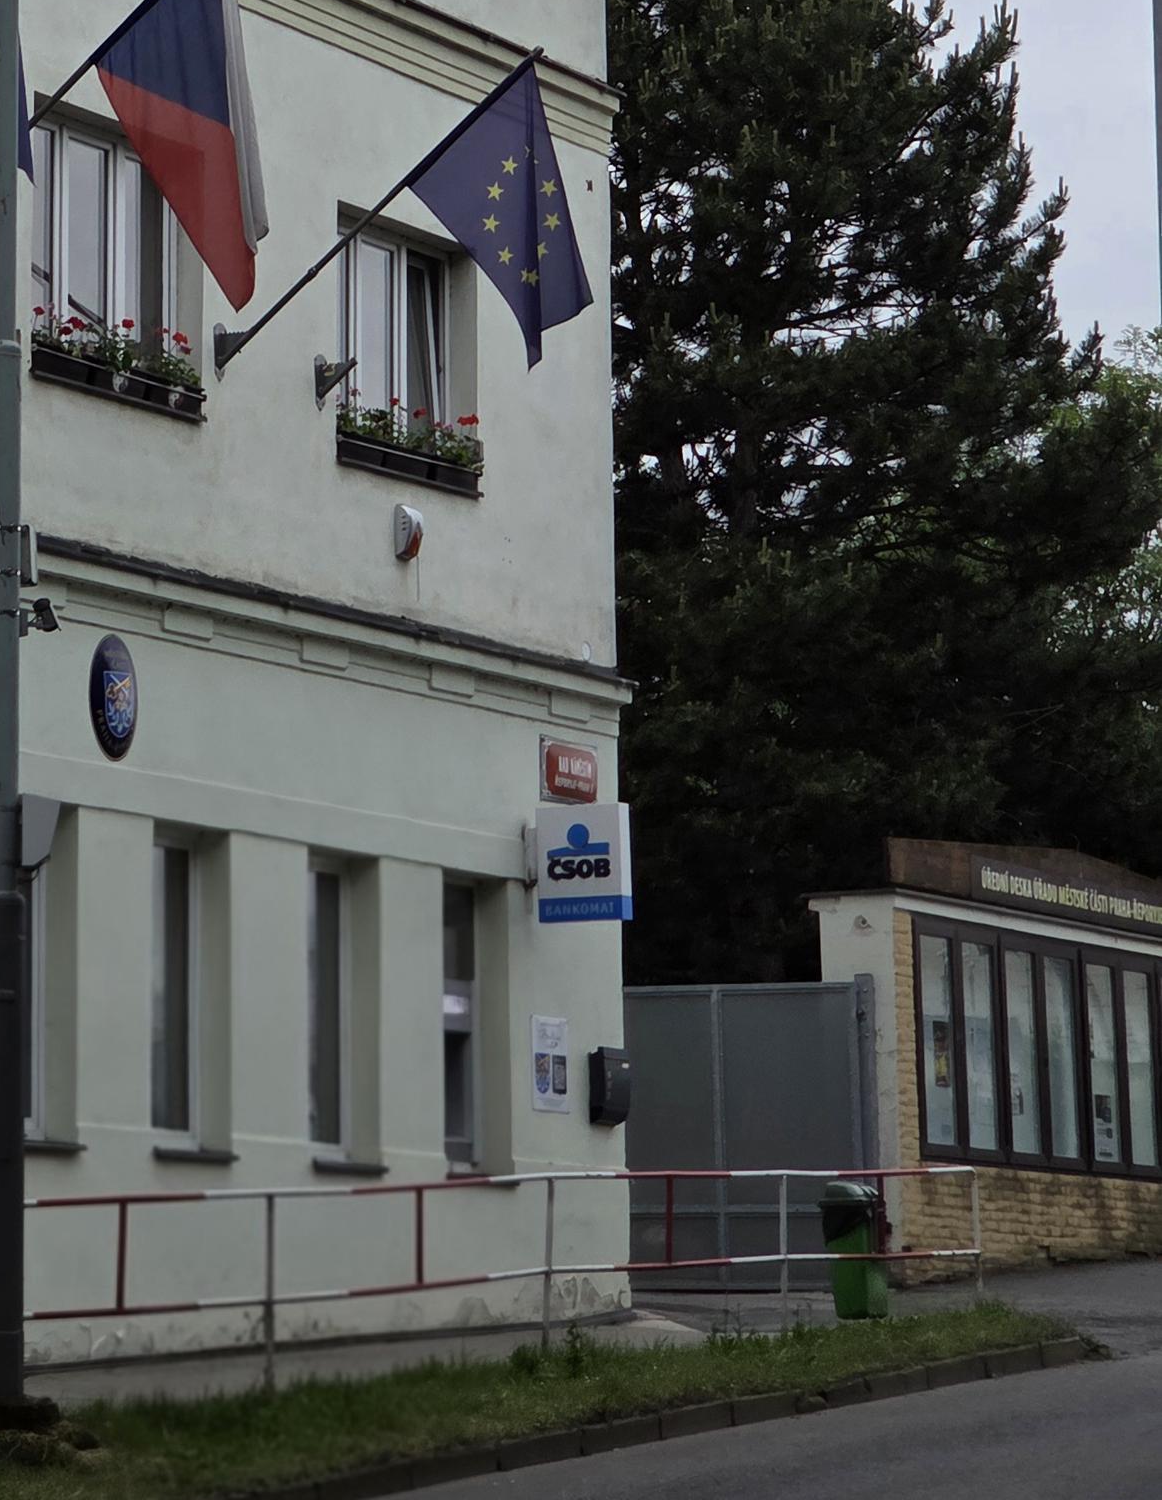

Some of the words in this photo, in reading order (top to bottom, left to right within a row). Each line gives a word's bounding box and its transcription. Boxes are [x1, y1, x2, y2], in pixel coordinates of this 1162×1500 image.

[547, 855, 611, 883] ČSOB
[981, 866, 1009, 893] ÚŘEDNÍ
[1010, 875, 1033, 898] DESKA
[1033, 876, 1057, 903] ÚŘADU
[545, 902, 614, 917] BANKOMAT
